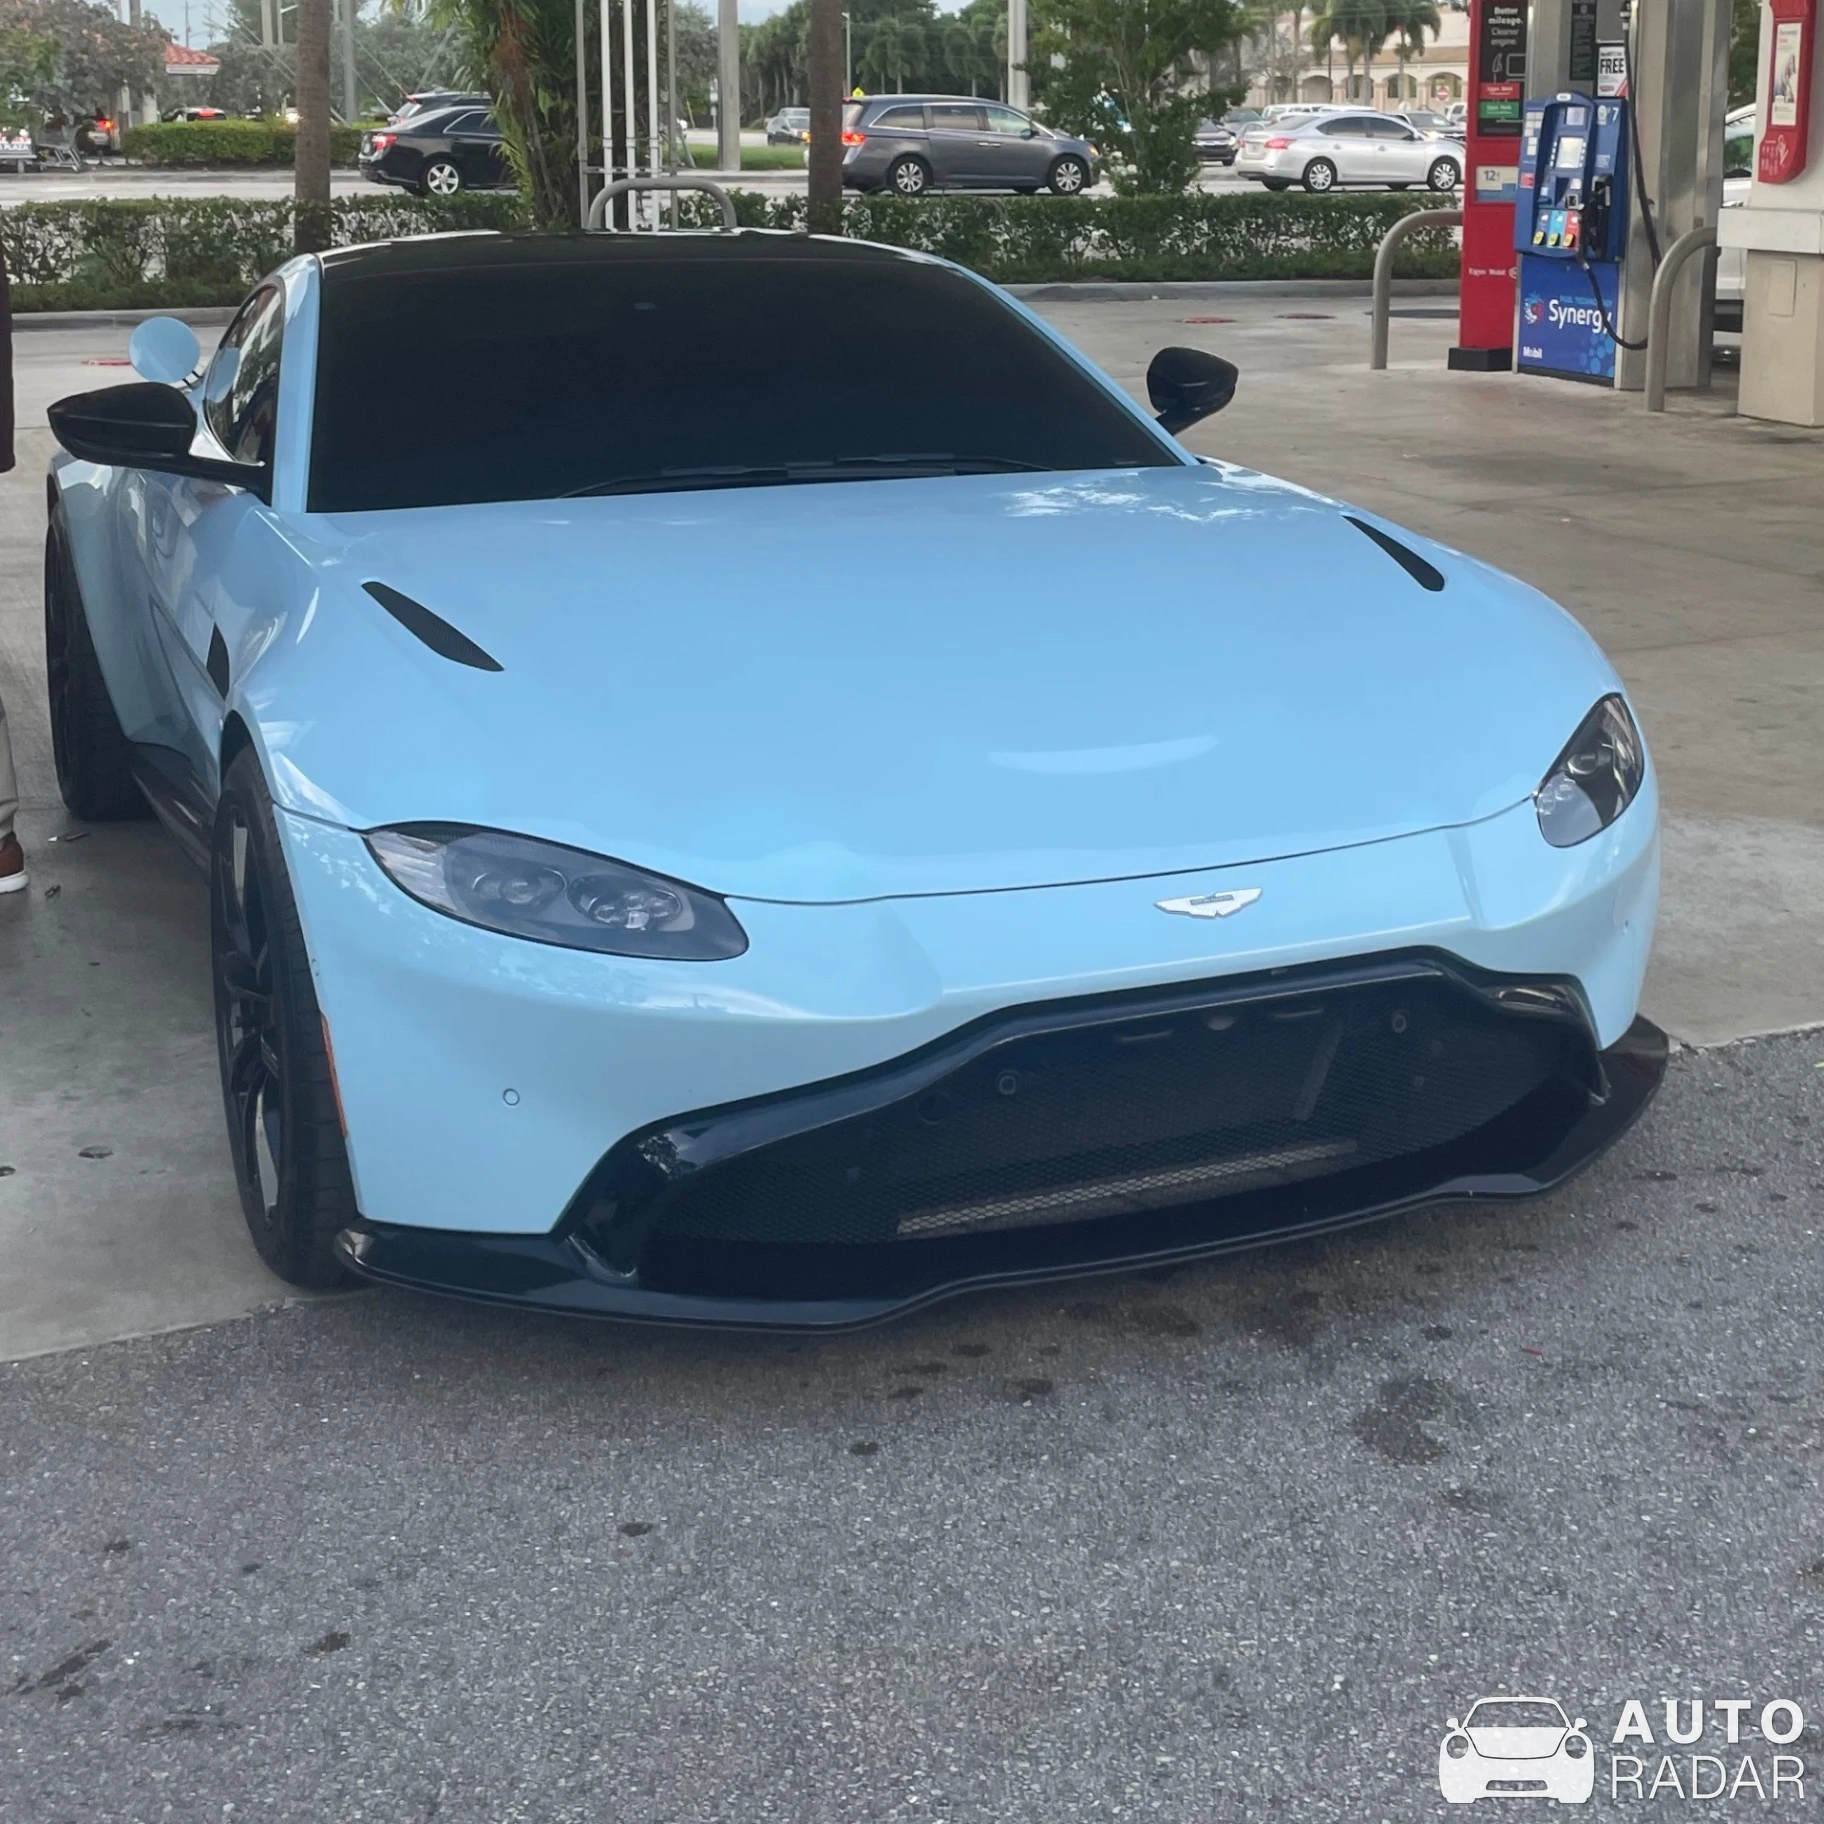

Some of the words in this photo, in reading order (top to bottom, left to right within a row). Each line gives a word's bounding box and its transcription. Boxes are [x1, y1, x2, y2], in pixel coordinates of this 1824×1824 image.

[1494, 7, 1519, 15] Better
[1488, 16, 1524, 26] mileage.
[1600, 58, 1624, 74] FREE
[1612, 106, 1620, 121] 7
[1523, 346, 1543, 359] Mobil
